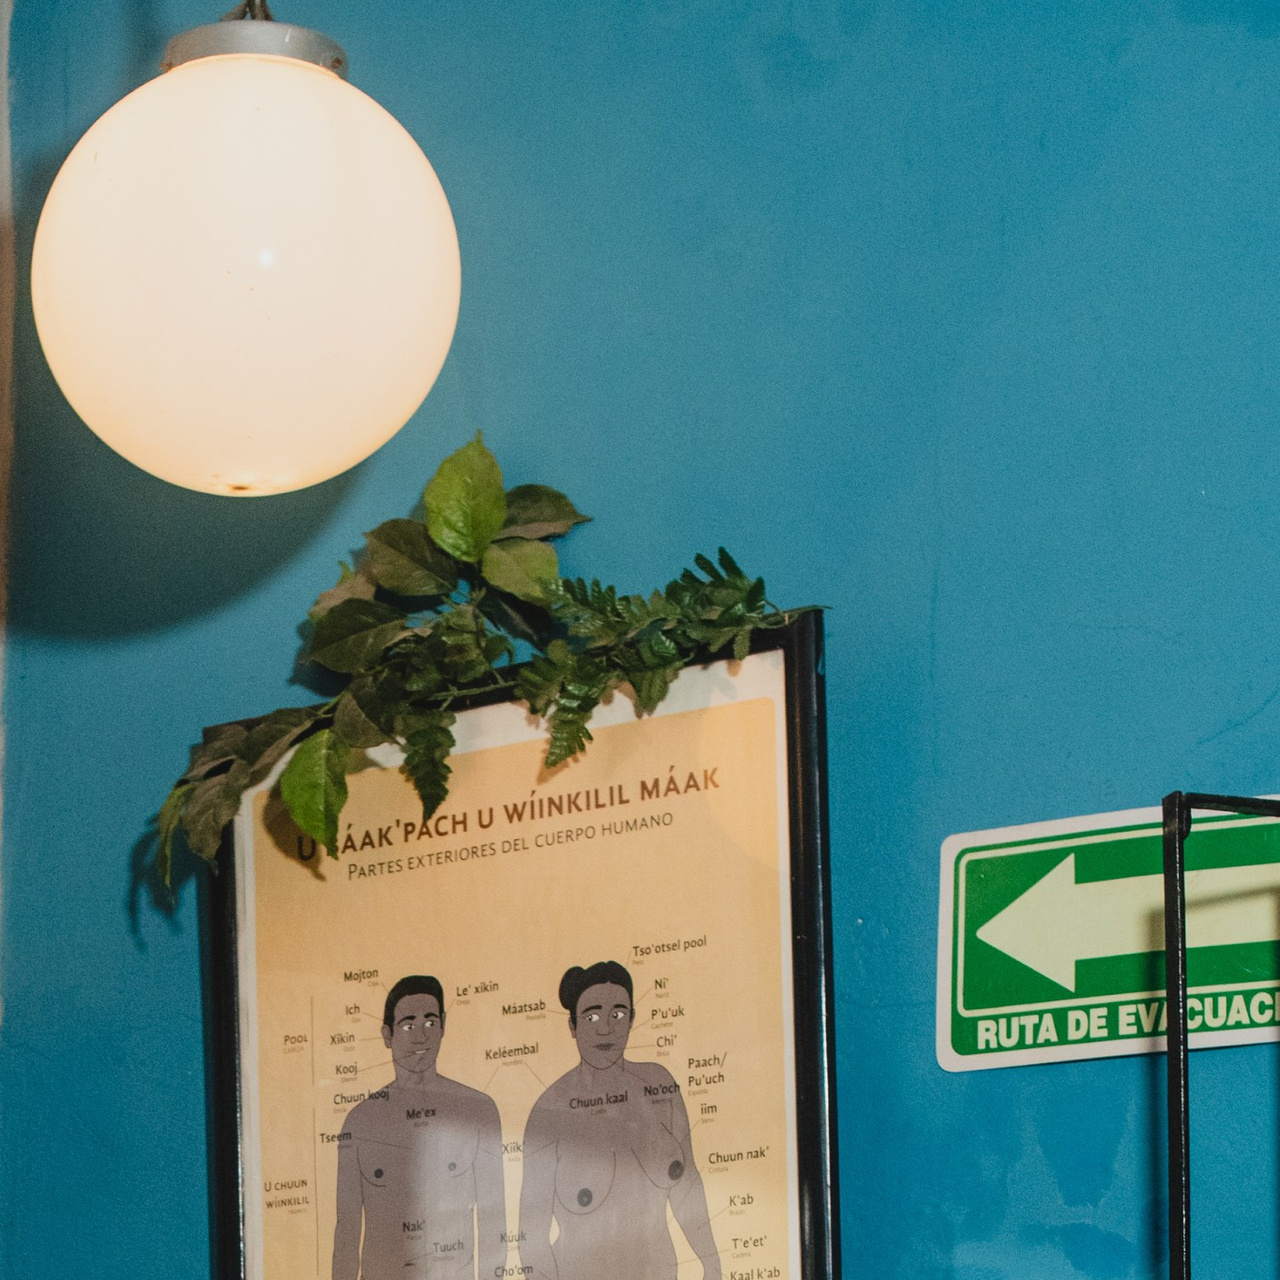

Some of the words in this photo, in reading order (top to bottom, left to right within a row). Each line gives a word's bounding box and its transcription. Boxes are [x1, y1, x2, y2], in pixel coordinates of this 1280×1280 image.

[297, 835, 317, 862] U
[327, 812, 468, 855] ÁAK'PACH
[477, 807, 495, 829] U
[503, 783, 630, 825] WÍINKILIL
[639, 765, 721, 800] MÁAK
[347, 858, 404, 881] PARTES
[407, 842, 497, 871] EXTERIORES
[501, 836, 530, 855] DEL
[534, 825, 597, 850] CUERPO
[601, 812, 674, 837] HUMANO
[632, 938, 680, 957] Tso'otsel
[683, 934, 707, 952] pool
[344, 969, 379, 984] Mojton
[654, 977, 670, 991] Ni'
[456, 984, 472, 997] Le'
[474, 980, 499, 995] xikin
[345, 1003, 360, 1016] Ich
[502, 999, 546, 1016] Máatsab
[651, 1005, 685, 1020] P'u'uk
[977, 1013, 1058, 1050] RUTA
[1067, 1007, 1108, 1041] DE
[330, 1032, 356, 1046] Xikin
[656, 1034, 677, 1048] Chi'
[485, 1042, 539, 1061] Keléembal
[335, 1061, 358, 1076] Kooj
[688, 1071, 725, 1087] Pu'uch
[333, 1092, 366, 1105] Chuun
[368, 1086, 390, 1102] kooj
[644, 1083, 680, 1097] No'och
[570, 1096, 603, 1109] Chuun
[606, 1090, 628, 1104] kaal
[406, 1107, 437, 1120] Me'ex
[319, 1132, 353, 1144] Tseem
[708, 1151, 744, 1165] Chuun
[746, 1145, 770, 1159] nak'
[264, 1180, 272, 1192] U
[729, 1193, 754, 1207] K'ab
[402, 1219, 426, 1232] Nak'
[432, 1239, 465, 1253] Tuuch
[494, 1264, 534, 1278] Cho'om
[757, 1266, 780, 1280] k'ab
